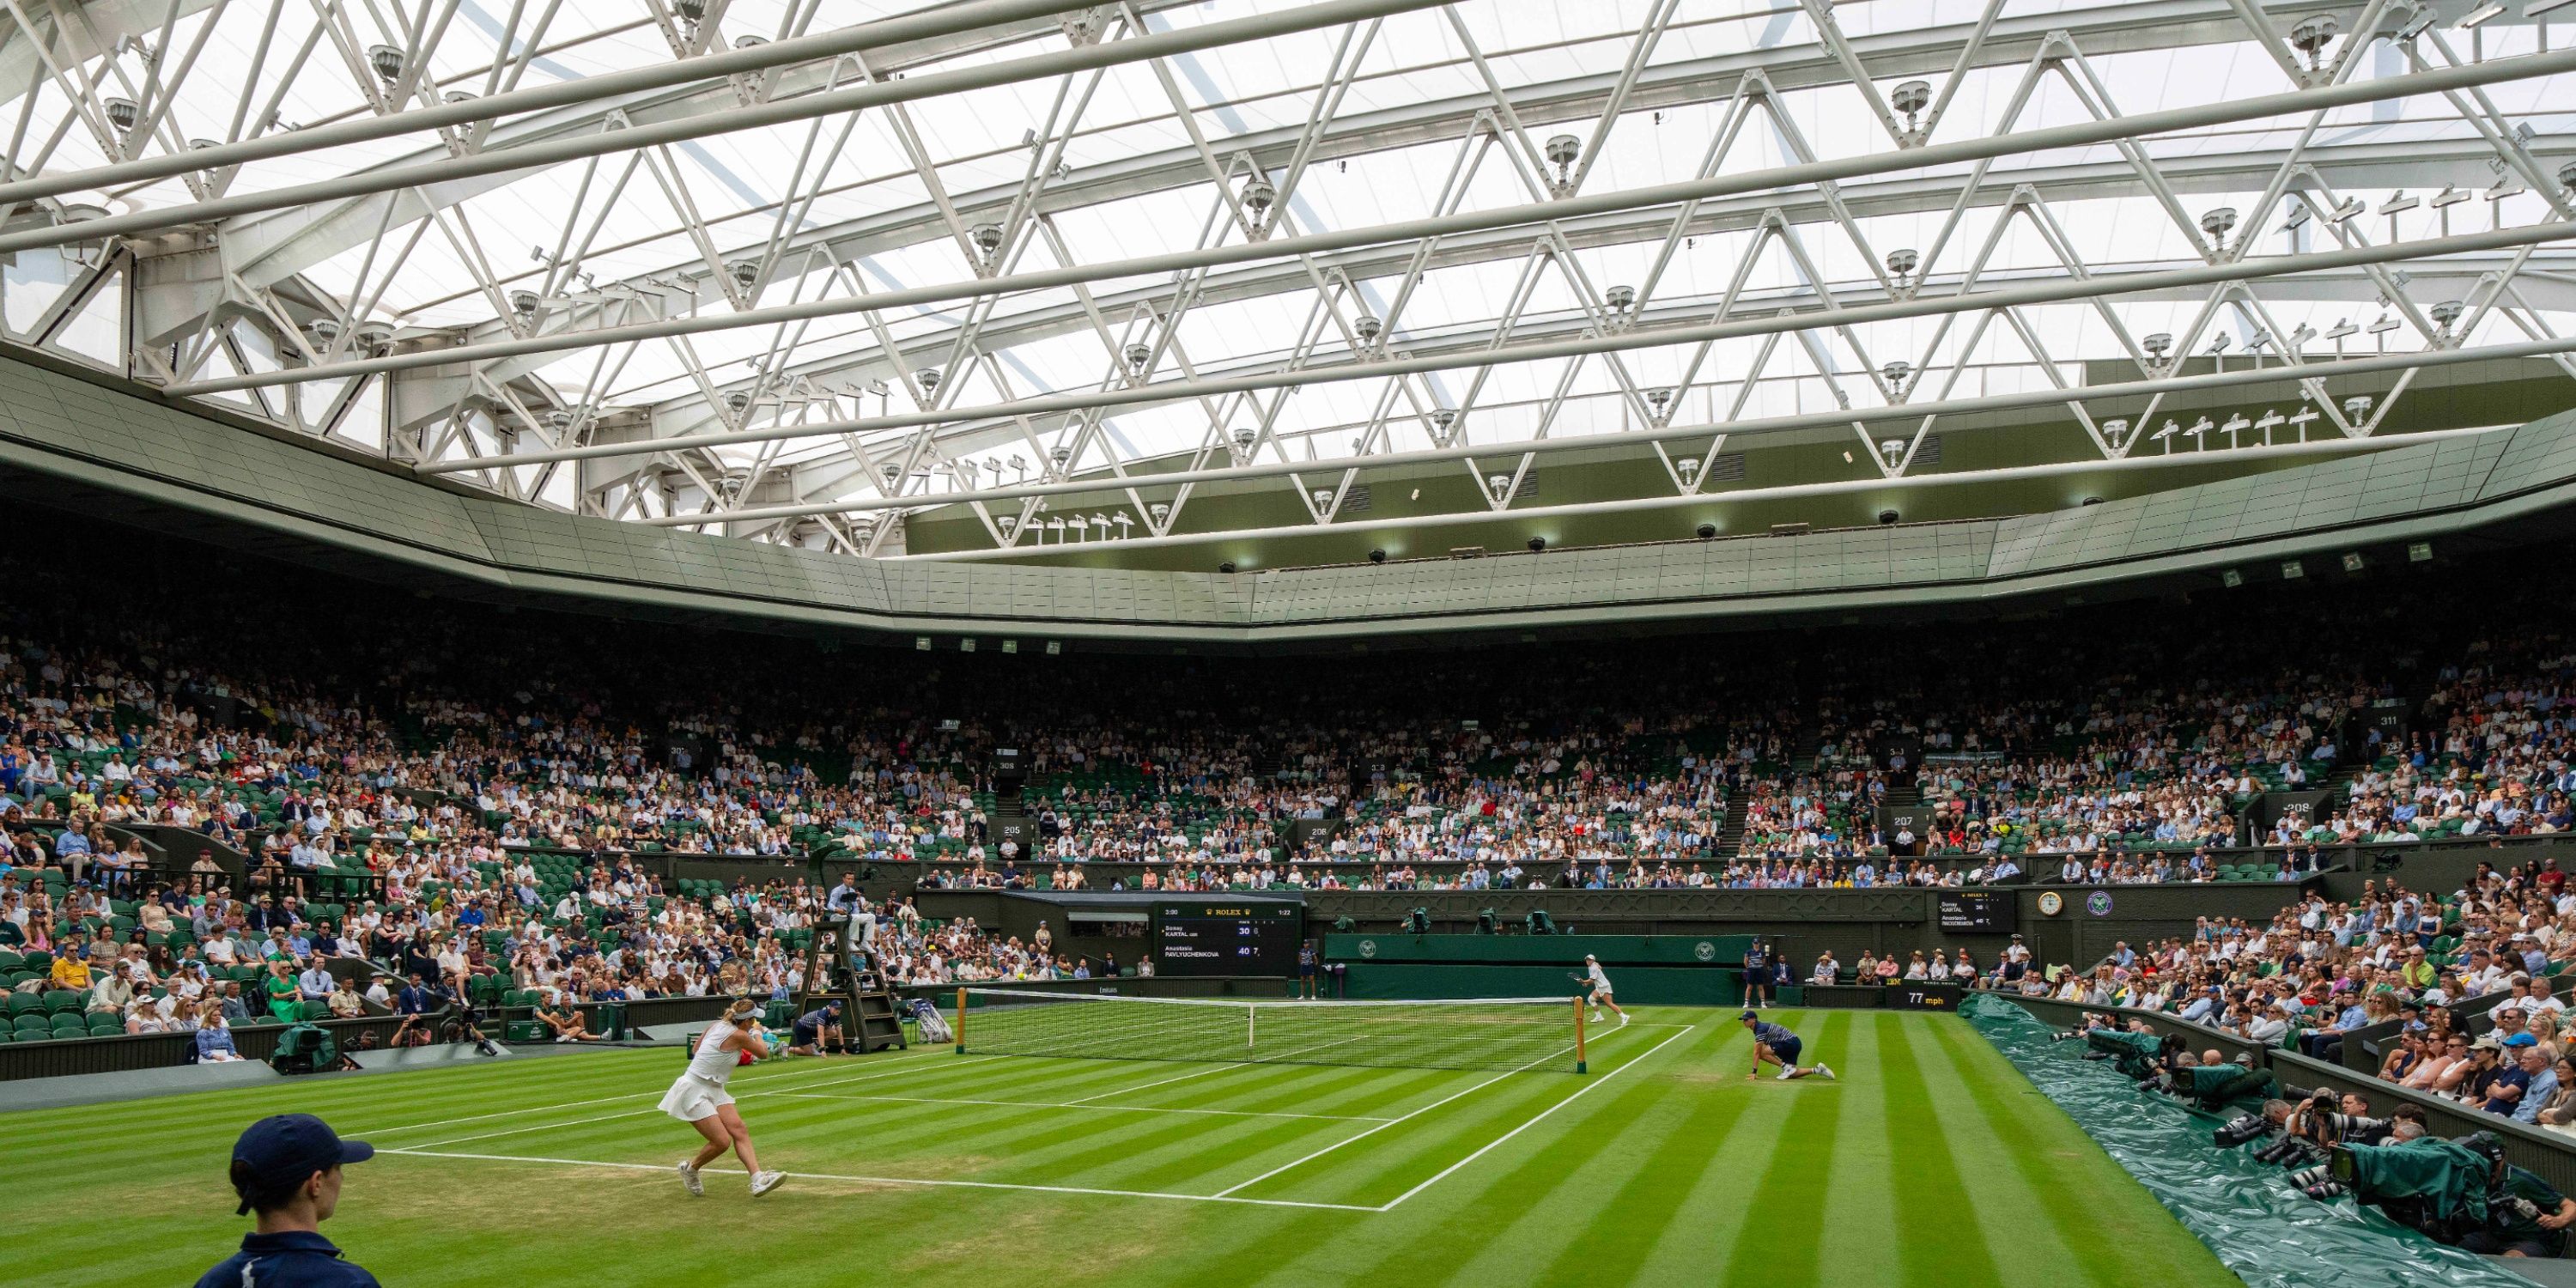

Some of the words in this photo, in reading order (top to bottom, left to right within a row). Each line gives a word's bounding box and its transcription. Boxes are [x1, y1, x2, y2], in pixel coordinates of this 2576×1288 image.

[2381, 716, 2397, 725] 311
[2287, 803, 2309, 812] 208
[1894, 817, 1913, 825] 207
[1908, 992, 1923, 1003] 77
[1925, 997, 1944, 1005] mph
